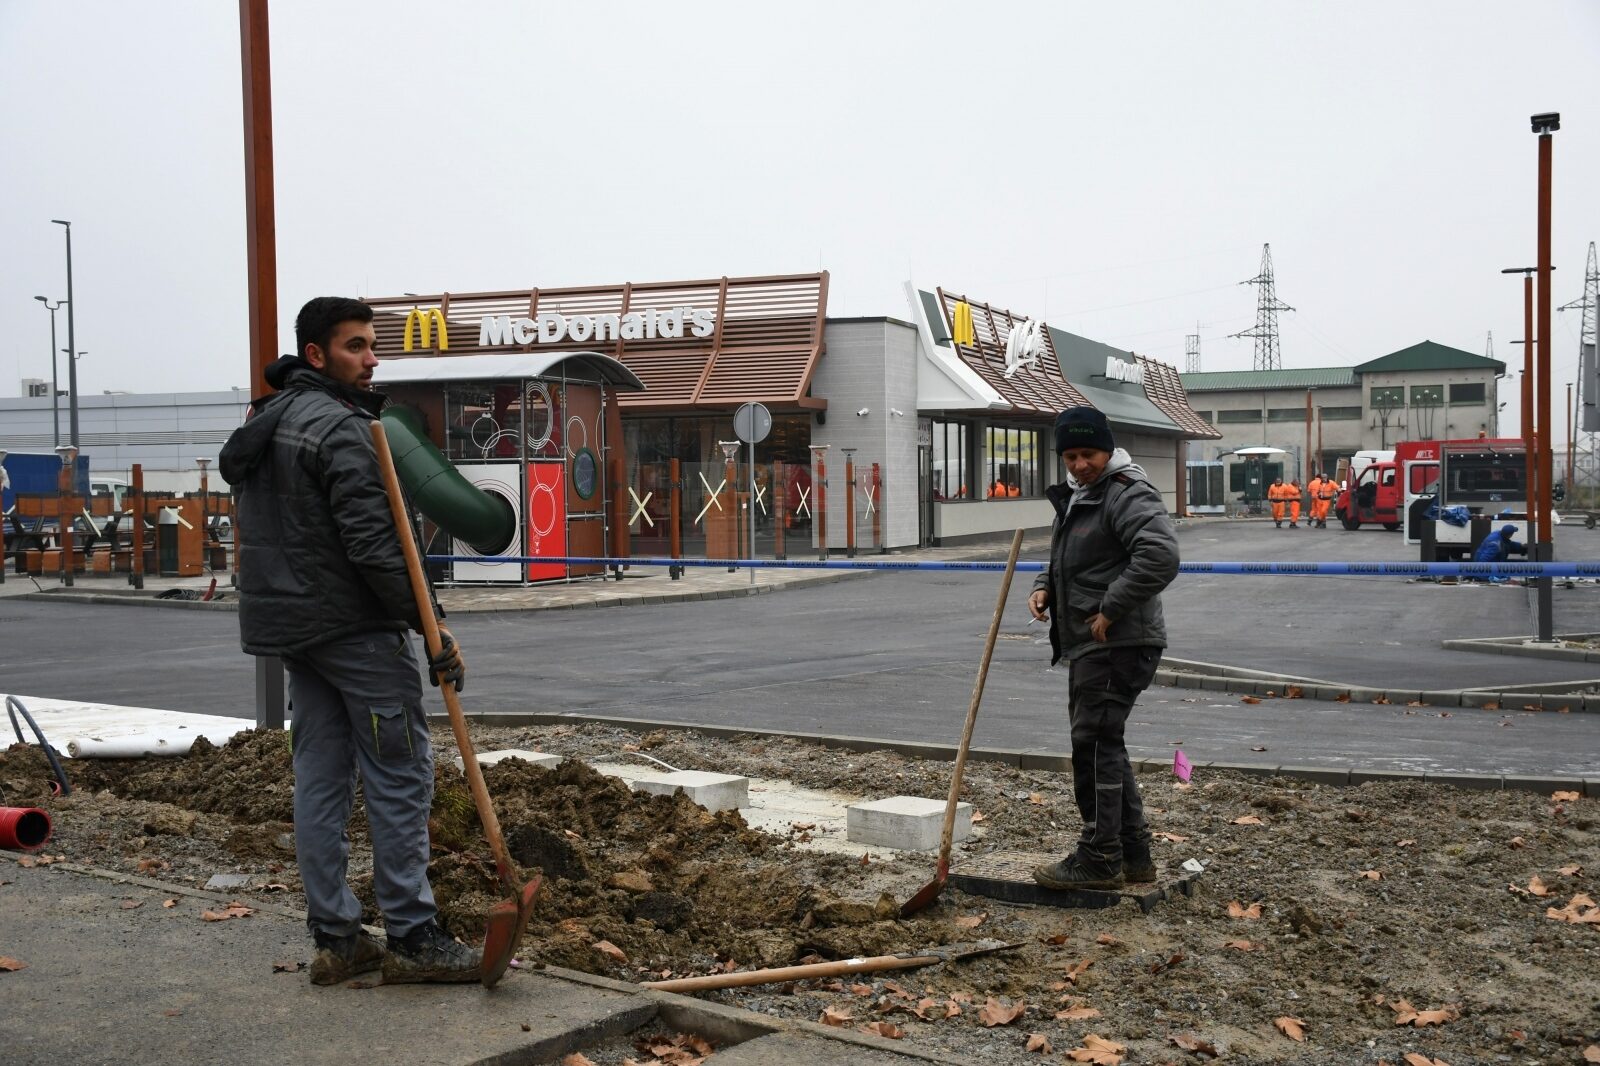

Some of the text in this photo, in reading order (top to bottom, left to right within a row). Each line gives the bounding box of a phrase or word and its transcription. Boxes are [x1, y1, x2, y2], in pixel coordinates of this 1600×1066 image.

[478, 306, 715, 347] McDonald's
[1347, 563, 1379, 572] POZOR
[1384, 563, 1428, 572] VODOVOD
[1459, 564, 1492, 573] POZOR
[1497, 564, 1543, 574] VODOVOD
